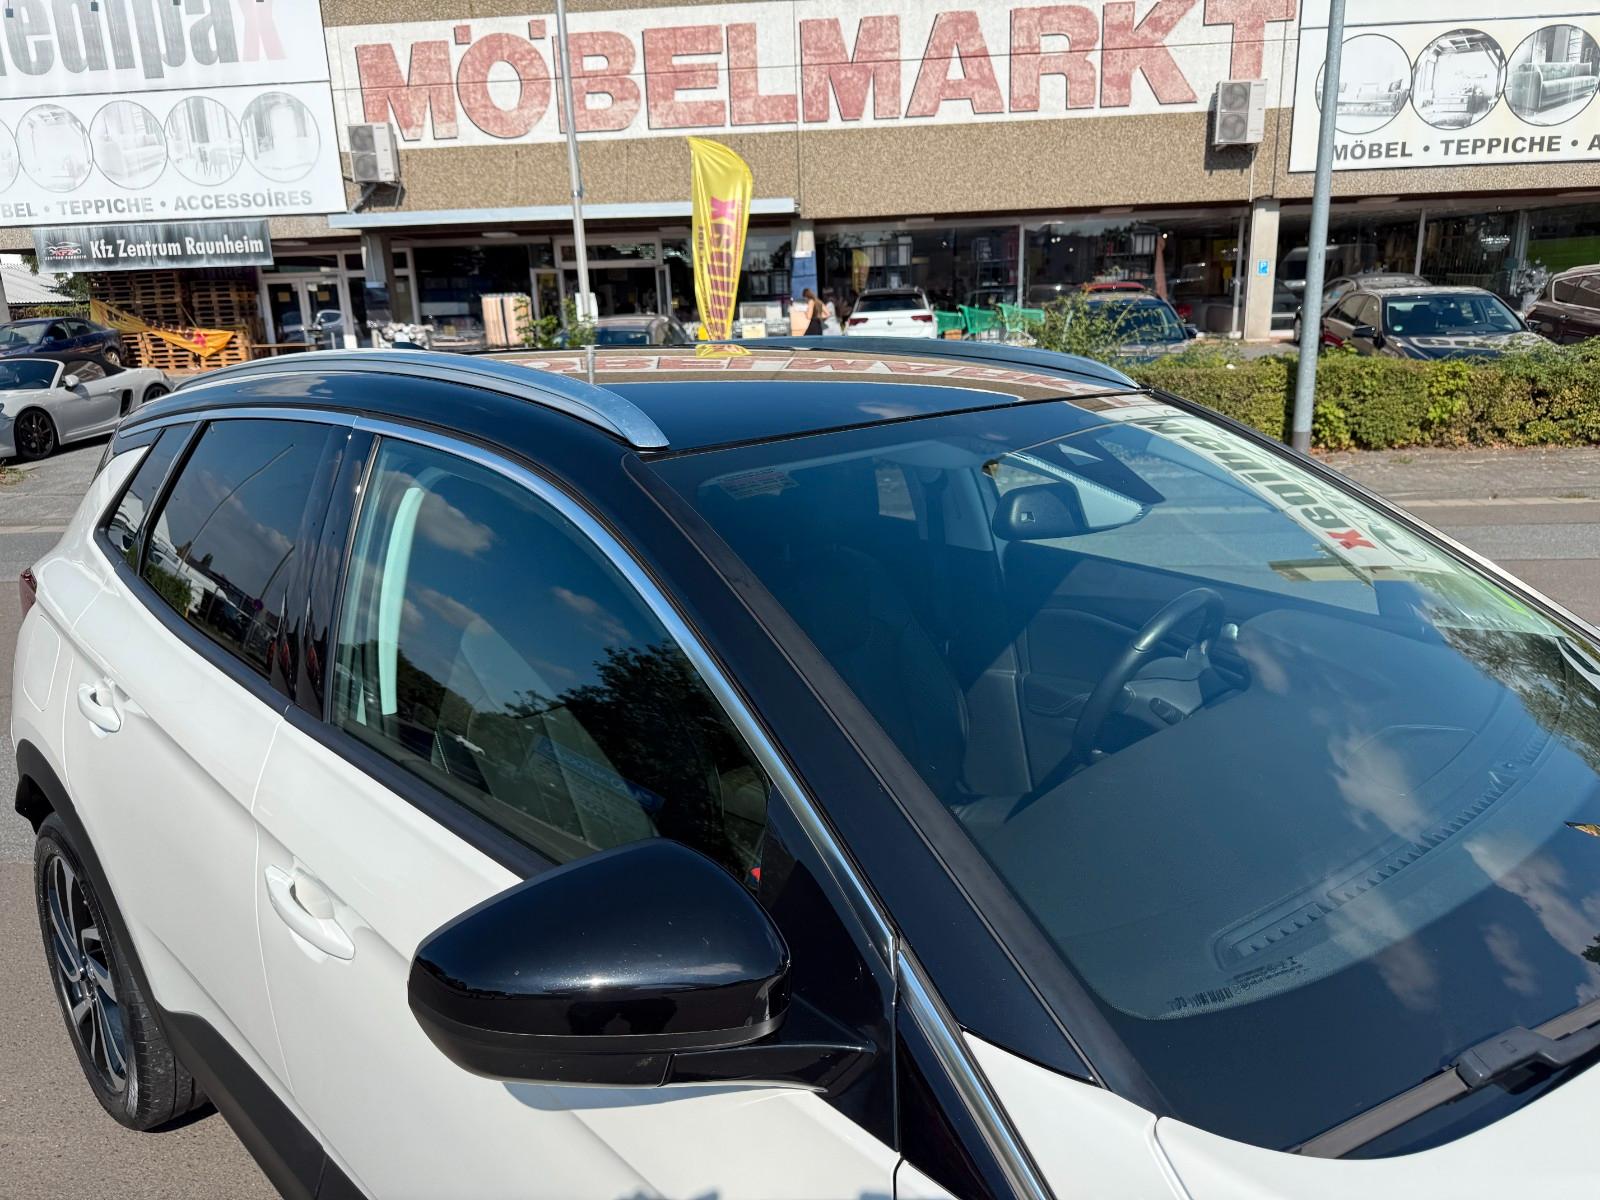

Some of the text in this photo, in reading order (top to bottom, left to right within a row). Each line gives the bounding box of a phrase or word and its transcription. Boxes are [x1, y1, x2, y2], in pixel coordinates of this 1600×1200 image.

[0, 0, 287, 79] edipax
[355, 0, 1297, 141] MÖBELMARKT
[1333, 140, 1413, 161] MÖBEL
[1439, 135, 1562, 156] TEPPICHE
[56, 197, 154, 215] TEPPICHE
[90, 234, 264, 258] Kfz Zentrum Raunheim
